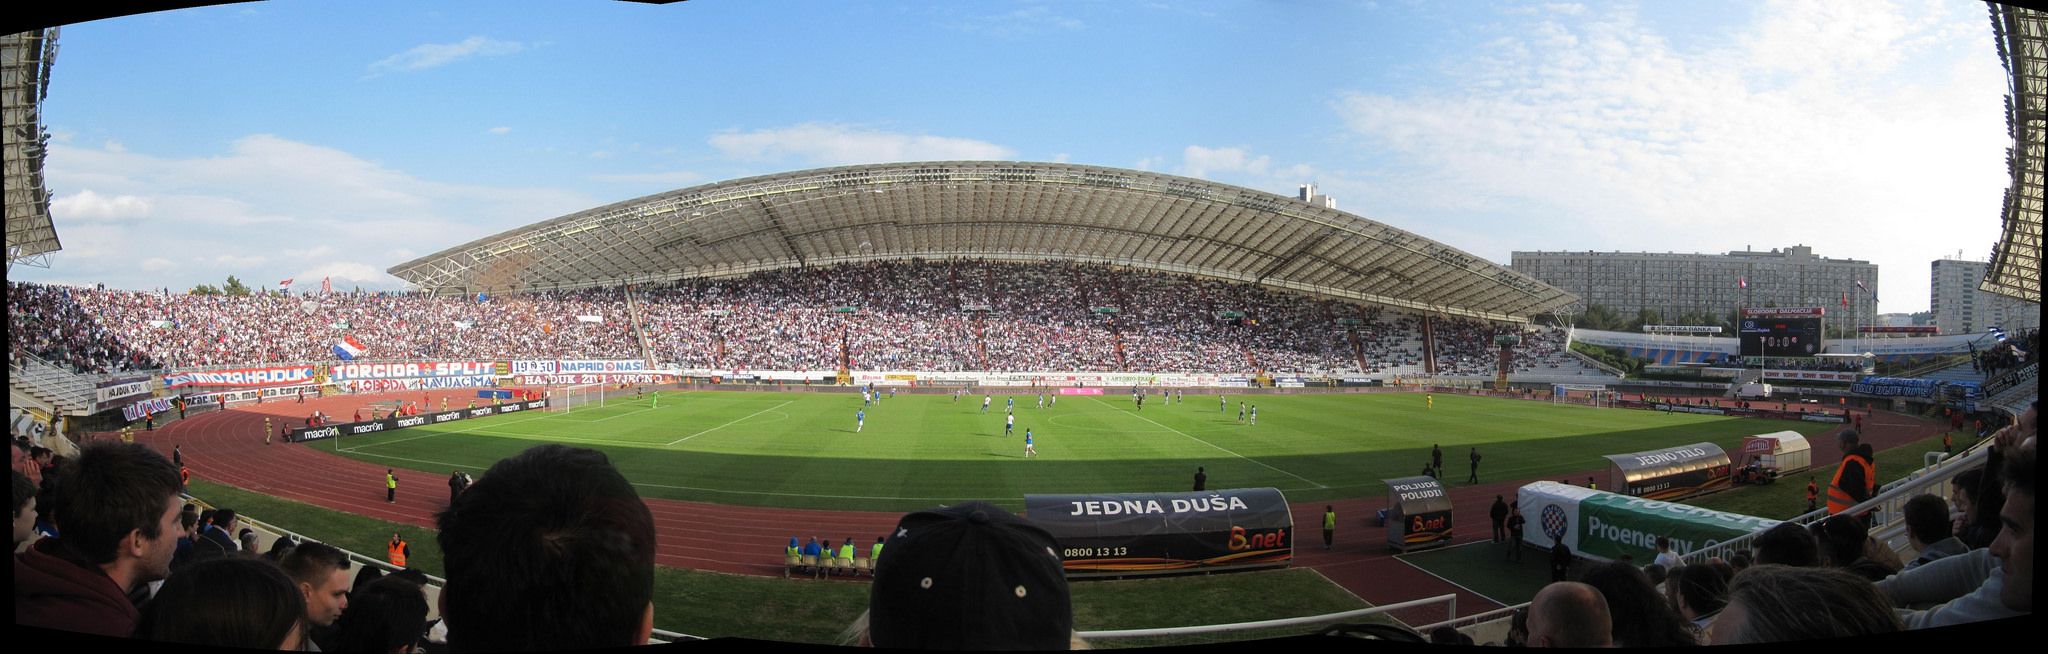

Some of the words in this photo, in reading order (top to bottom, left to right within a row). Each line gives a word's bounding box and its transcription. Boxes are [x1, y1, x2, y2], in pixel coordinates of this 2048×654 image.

[333, 363, 420, 380] TORCIDA
[435, 362, 495, 376] SPLIT
[560, 362, 605, 372] NAPRID
[246, 368, 309, 384] HAJDUK
[242, 389, 282, 401] maka
[353, 422, 383, 434] macron
[1635, 454, 1677, 466] JEDNO
[1677, 447, 1706, 459] TILO
[1393, 481, 1440, 492] POLJUDE
[1400, 489, 1443, 501] POLUDI!
[1070, 500, 1165, 516] JEDNA
[1170, 494, 1248, 513] DUŠA
[1228, 525, 1285, 552] B.net
[1587, 515, 1694, 555] Proenegy
[1063, 547, 1093, 558] 0800
[1096, 547, 1110, 557] 13
[1113, 546, 1127, 556] 13
